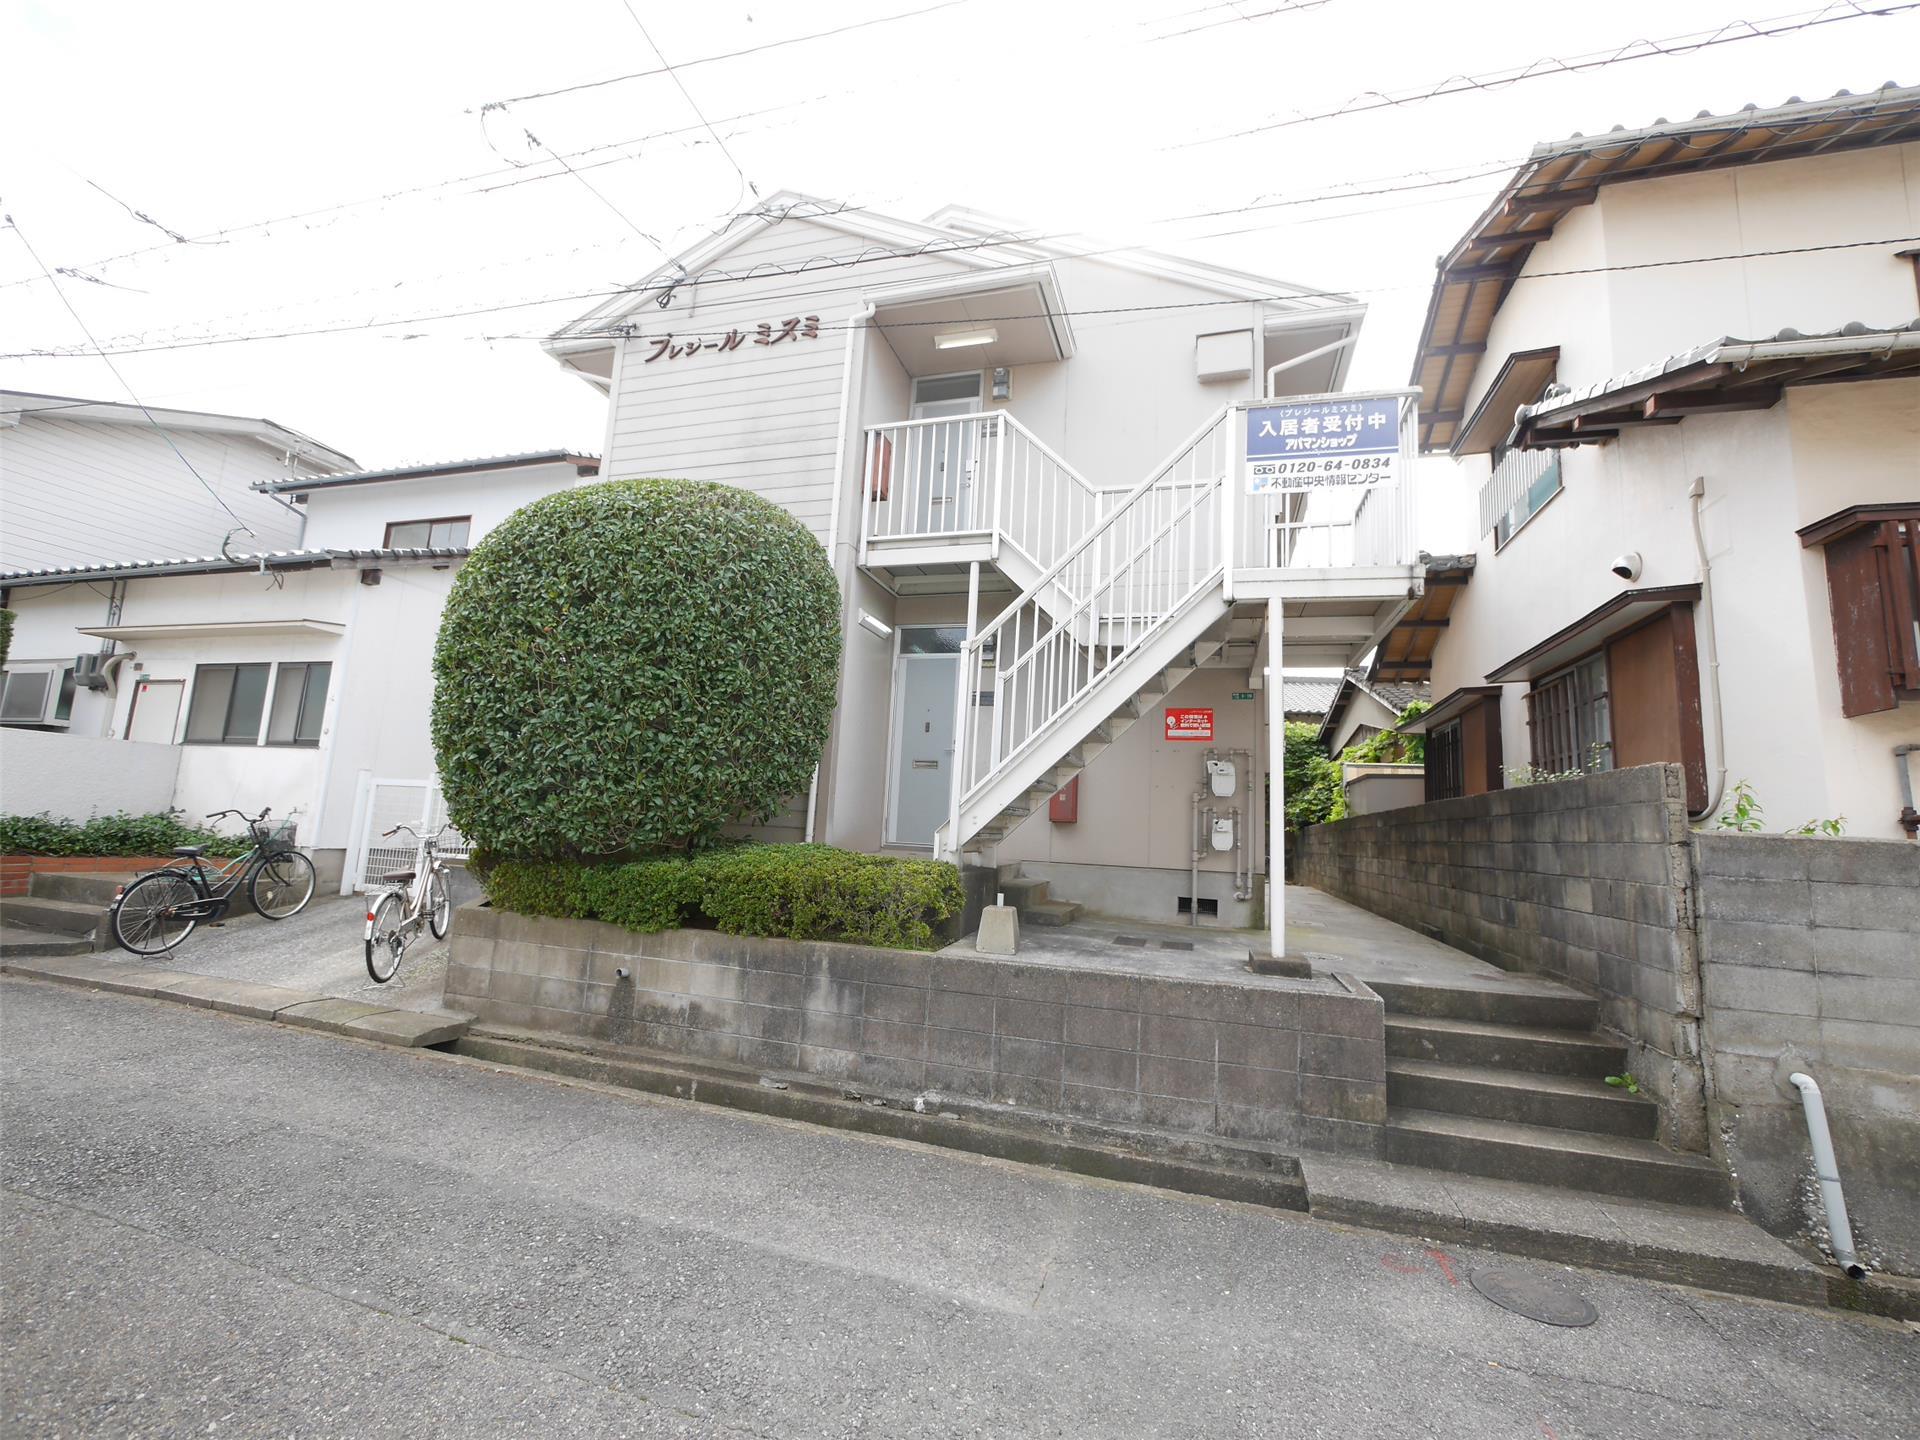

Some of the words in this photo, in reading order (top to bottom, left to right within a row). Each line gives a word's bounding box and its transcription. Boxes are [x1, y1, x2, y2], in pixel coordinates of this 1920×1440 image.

[753, 315, 820, 346] ミスミ
[1259, 413, 1385, 437] 入居者受付中
[1285, 434, 1357, 450] アパマンショップ
[1277, 457, 1391, 474] 0120-64-0834
[1271, 472, 1391, 489] 不動産中央情報センター
